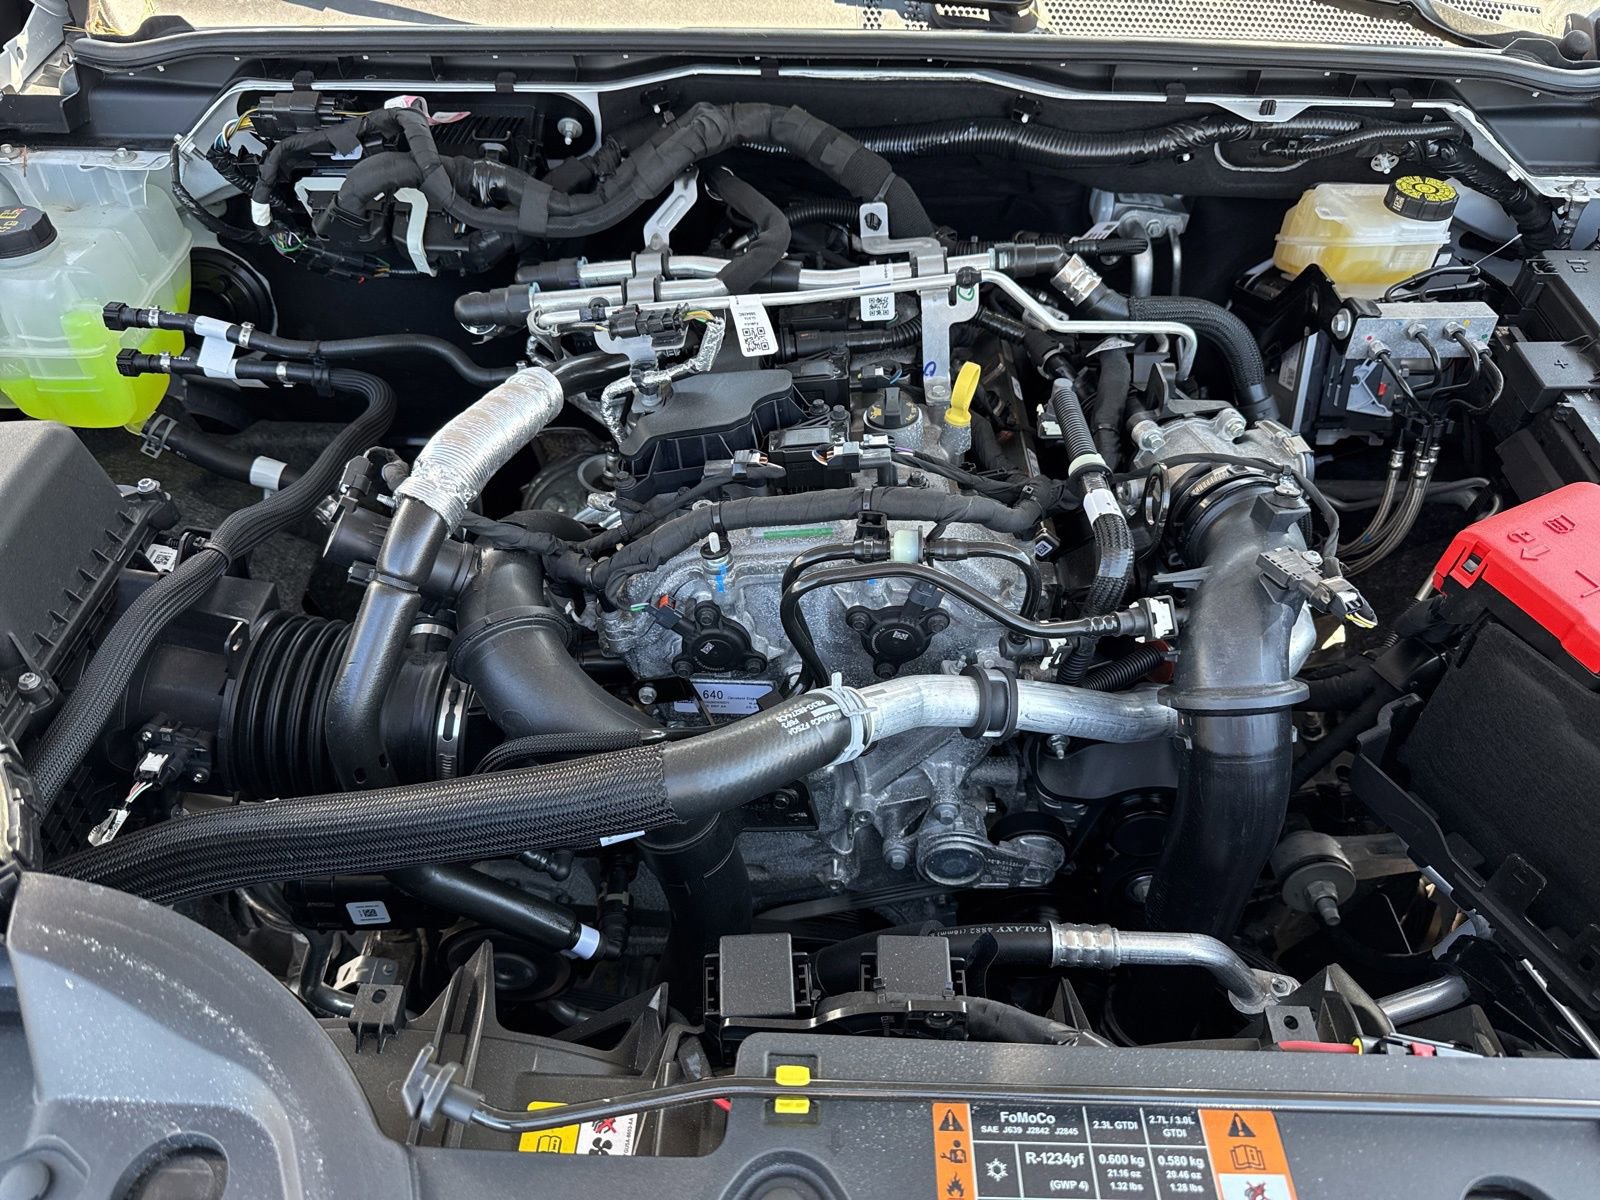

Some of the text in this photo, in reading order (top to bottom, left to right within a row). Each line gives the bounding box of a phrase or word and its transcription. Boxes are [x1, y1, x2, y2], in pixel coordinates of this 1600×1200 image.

[702, 689, 723, 700] 640
[1000, 1111, 1056, 1124] FoMoCo
[1148, 1115, 1168, 1124] 2.7L
[1175, 1116, 1195, 1125] 3.0L
[980, 1125, 1079, 1136] SAE J639 J2842 J2845
[1092, 1120, 1138, 1130] 2.3L GTDI
[1162, 1128, 1187, 1138] GTDI
[1025, 1151, 1085, 1168] R-1234yf
[1098, 1153, 1145, 1168] 0.600 kg
[1157, 1155, 1205, 1169] 0.580 kg
[1050, 1180, 1089, 1192] (GWP 4)
[1110, 1182, 1144, 1191] 1.32 lbs
[1170, 1183, 1204, 1192] 1.28 lbs
